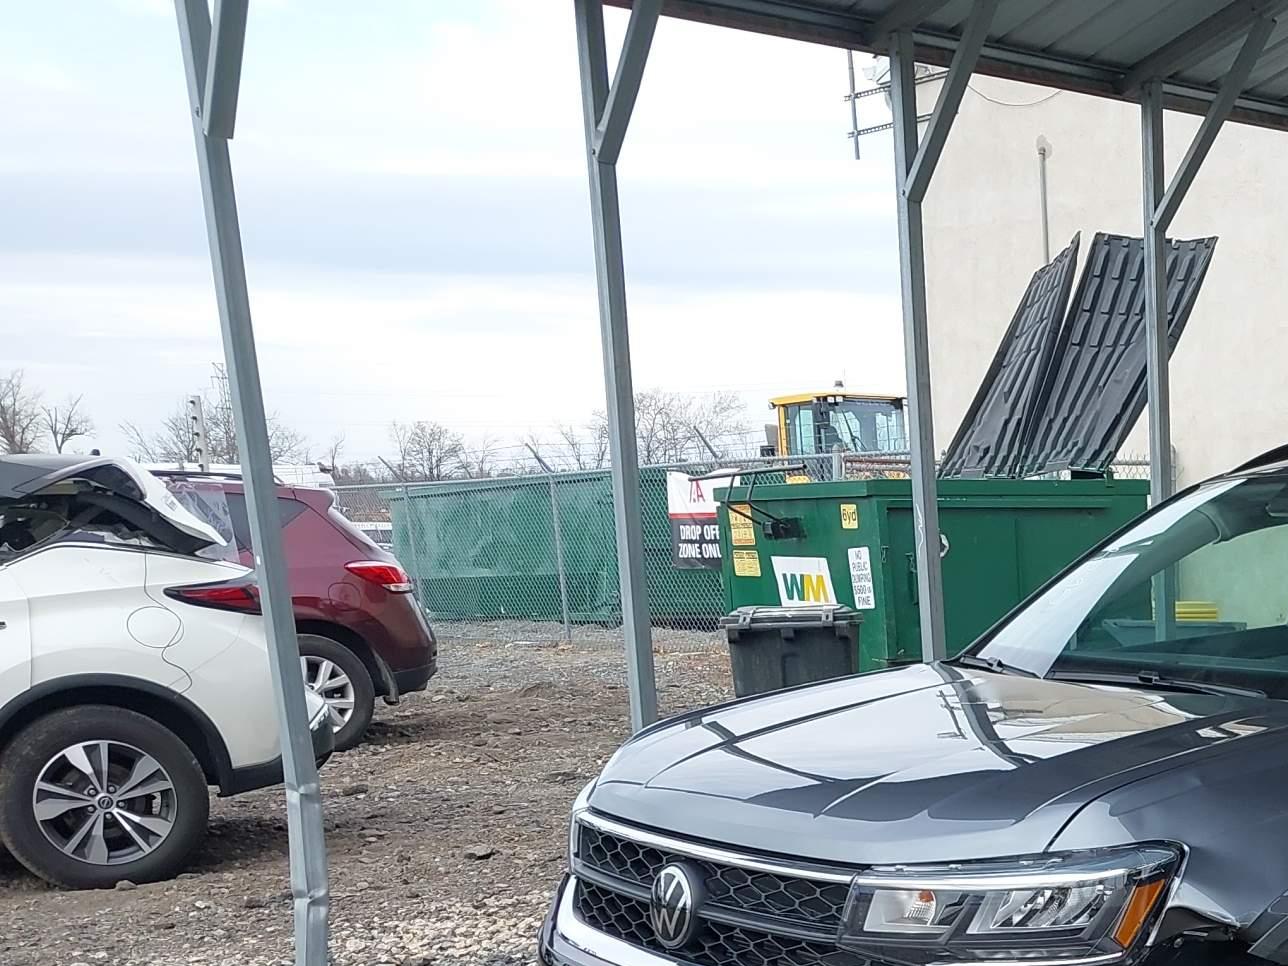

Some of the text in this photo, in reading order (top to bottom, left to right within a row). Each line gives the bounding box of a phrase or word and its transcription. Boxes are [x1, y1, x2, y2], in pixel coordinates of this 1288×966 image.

[679, 524, 702, 541] DROP
[678, 543, 722, 558] ZONE ONL
[782, 573, 830, 603] WM
[857, 596, 872, 607] FINE
